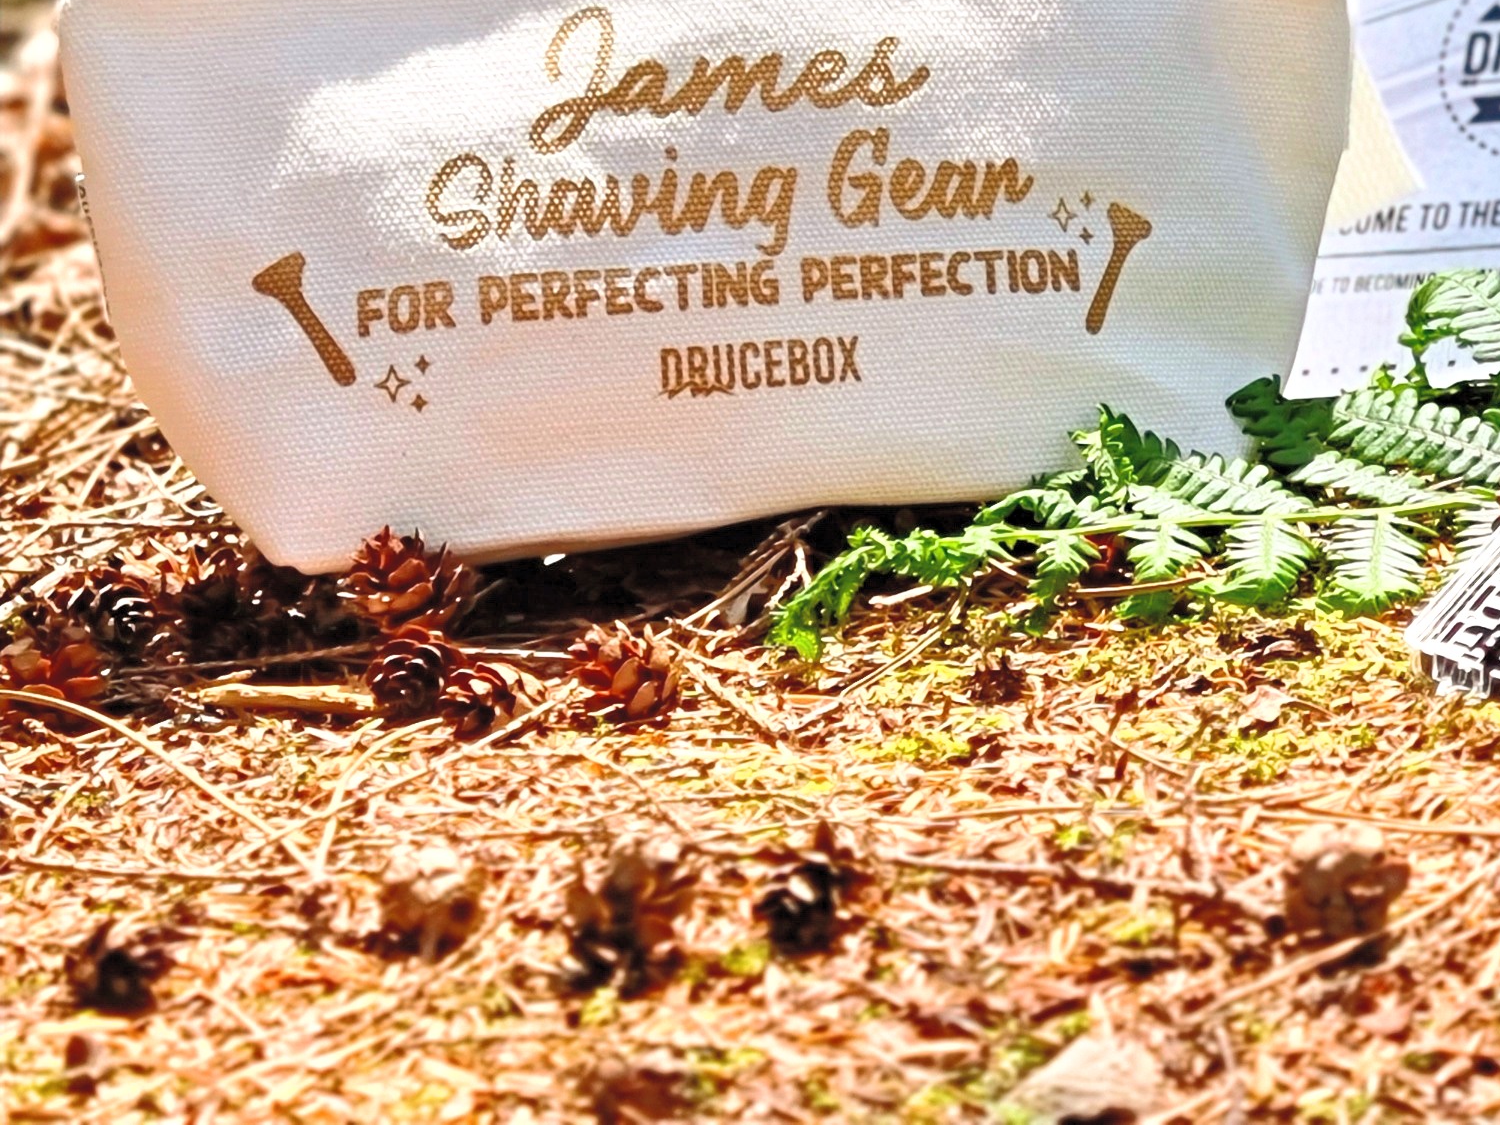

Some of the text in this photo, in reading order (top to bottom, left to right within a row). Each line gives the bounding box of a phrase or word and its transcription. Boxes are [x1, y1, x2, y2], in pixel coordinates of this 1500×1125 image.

[529, 6, 931, 155] James
[426, 127, 1036, 257] Shaving Gear
[1420, 202, 1450, 231] TO
[356, 248, 1082, 338] FOR PERFECTING PERFECTION
[659, 336, 862, 395] DRUCEBOX
